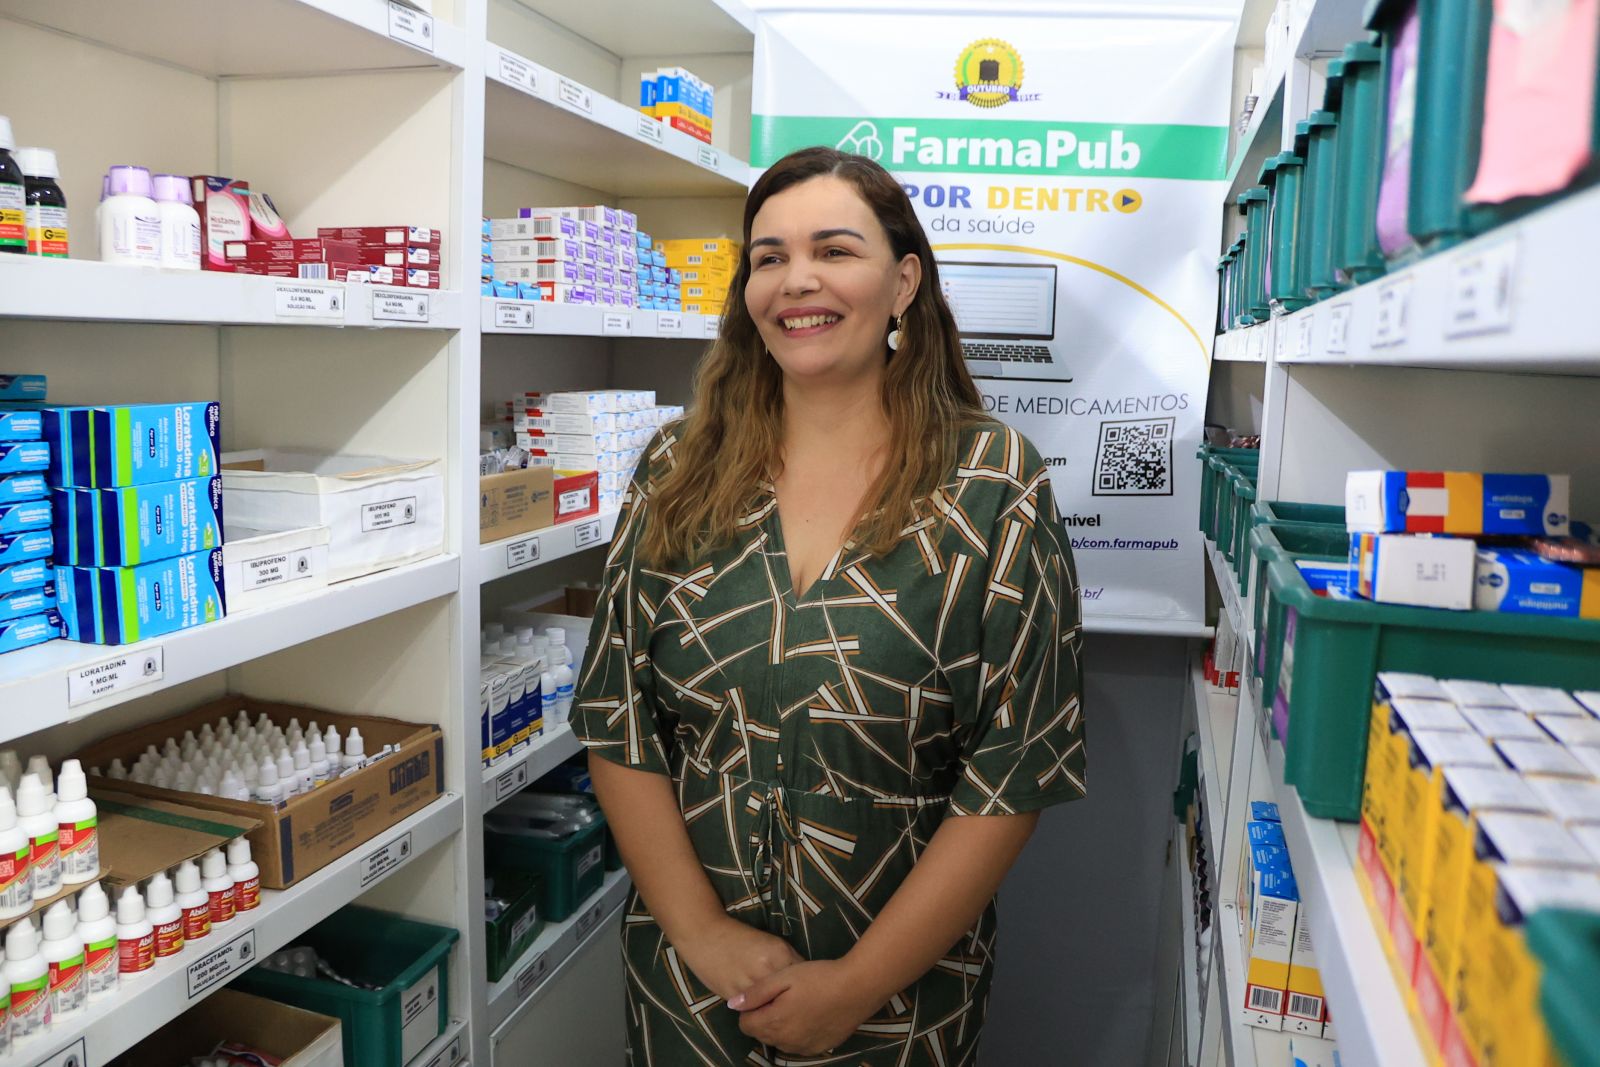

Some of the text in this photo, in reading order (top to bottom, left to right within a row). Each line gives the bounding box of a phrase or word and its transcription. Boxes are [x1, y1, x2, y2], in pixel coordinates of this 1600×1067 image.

[892, 126, 1140, 170] FarmaPub
[932, 214, 1034, 234] da saúde
[982, 394, 1189, 415] DE MEDICAMENTOS
[183, 406, 192, 476] Loratadina
[1044, 458, 1066, 466] em
[188, 481, 198, 551] Loratadina
[250, 556, 286, 568] IBUPROFENO
[187, 556, 198, 624] Loratadina
[80, 659, 126, 678] LORATADINA
[190, 946, 233, 974] PARACETAMOL
[197, 970, 208, 980] 200
